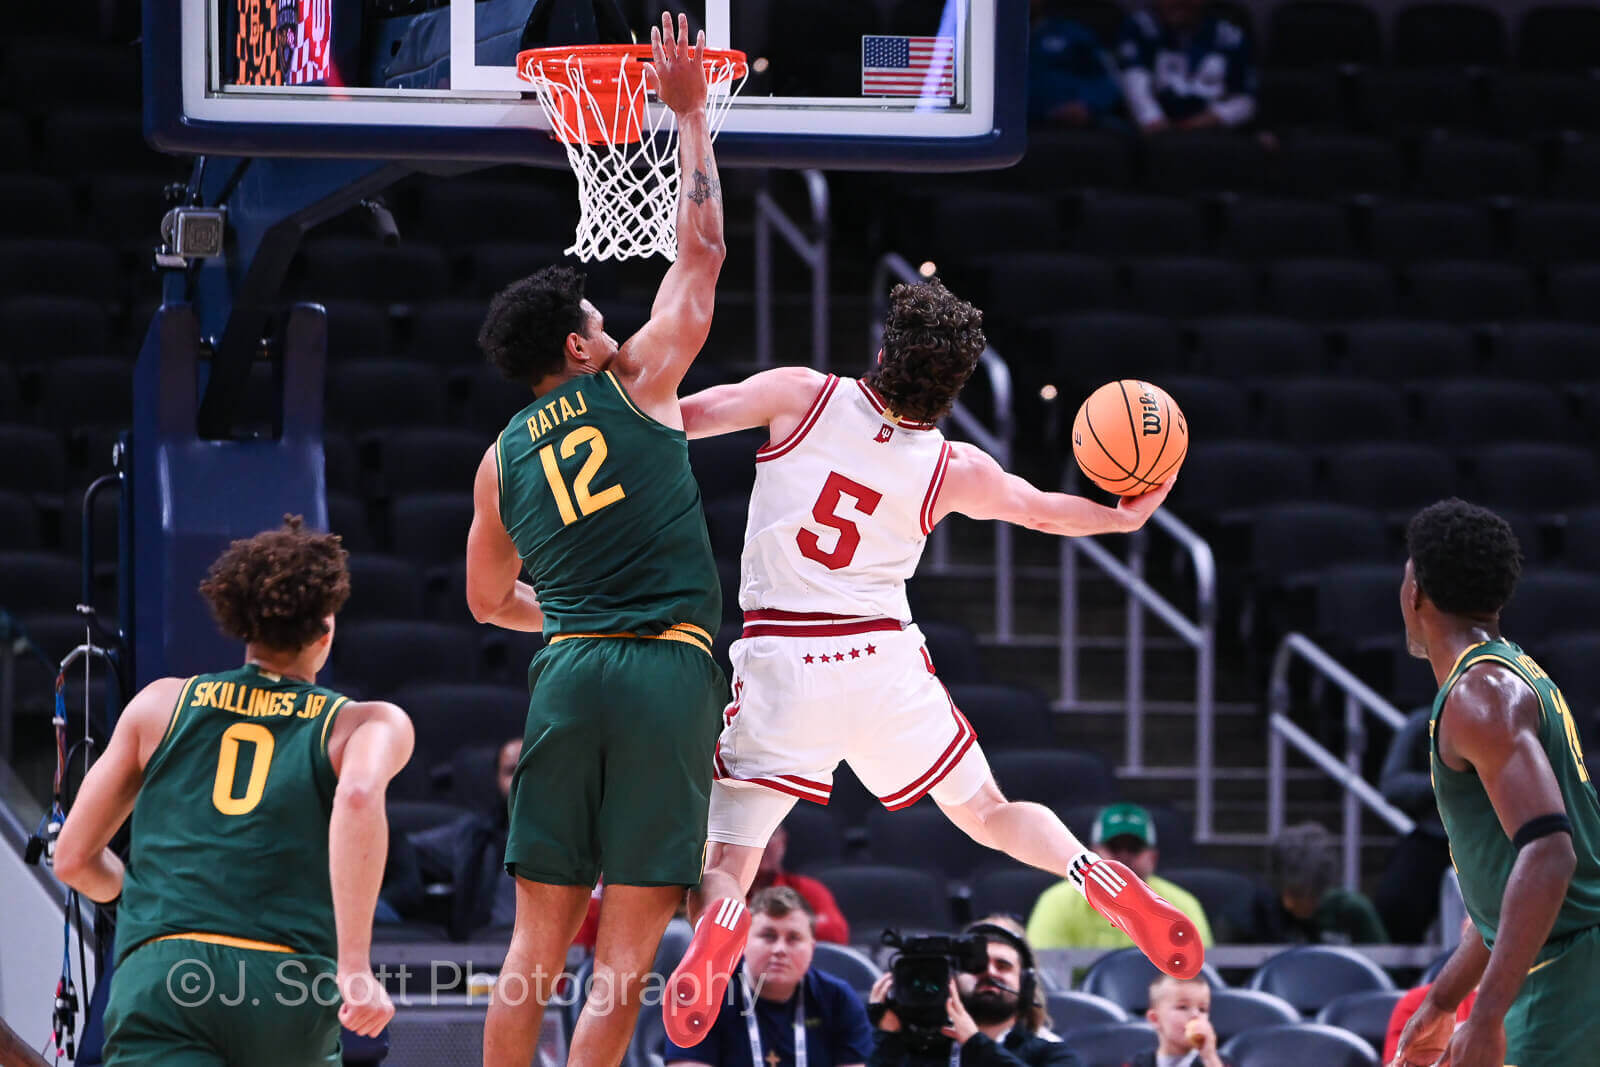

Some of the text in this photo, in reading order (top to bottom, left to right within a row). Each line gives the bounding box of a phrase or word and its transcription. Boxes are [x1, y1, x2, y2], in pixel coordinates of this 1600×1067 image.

[526, 390, 588, 442] RATAJ
[539, 425, 626, 526] 12
[796, 470, 883, 570] 5
[190, 681, 328, 719] SKILLINGS JR
[212, 722, 275, 816] 0
